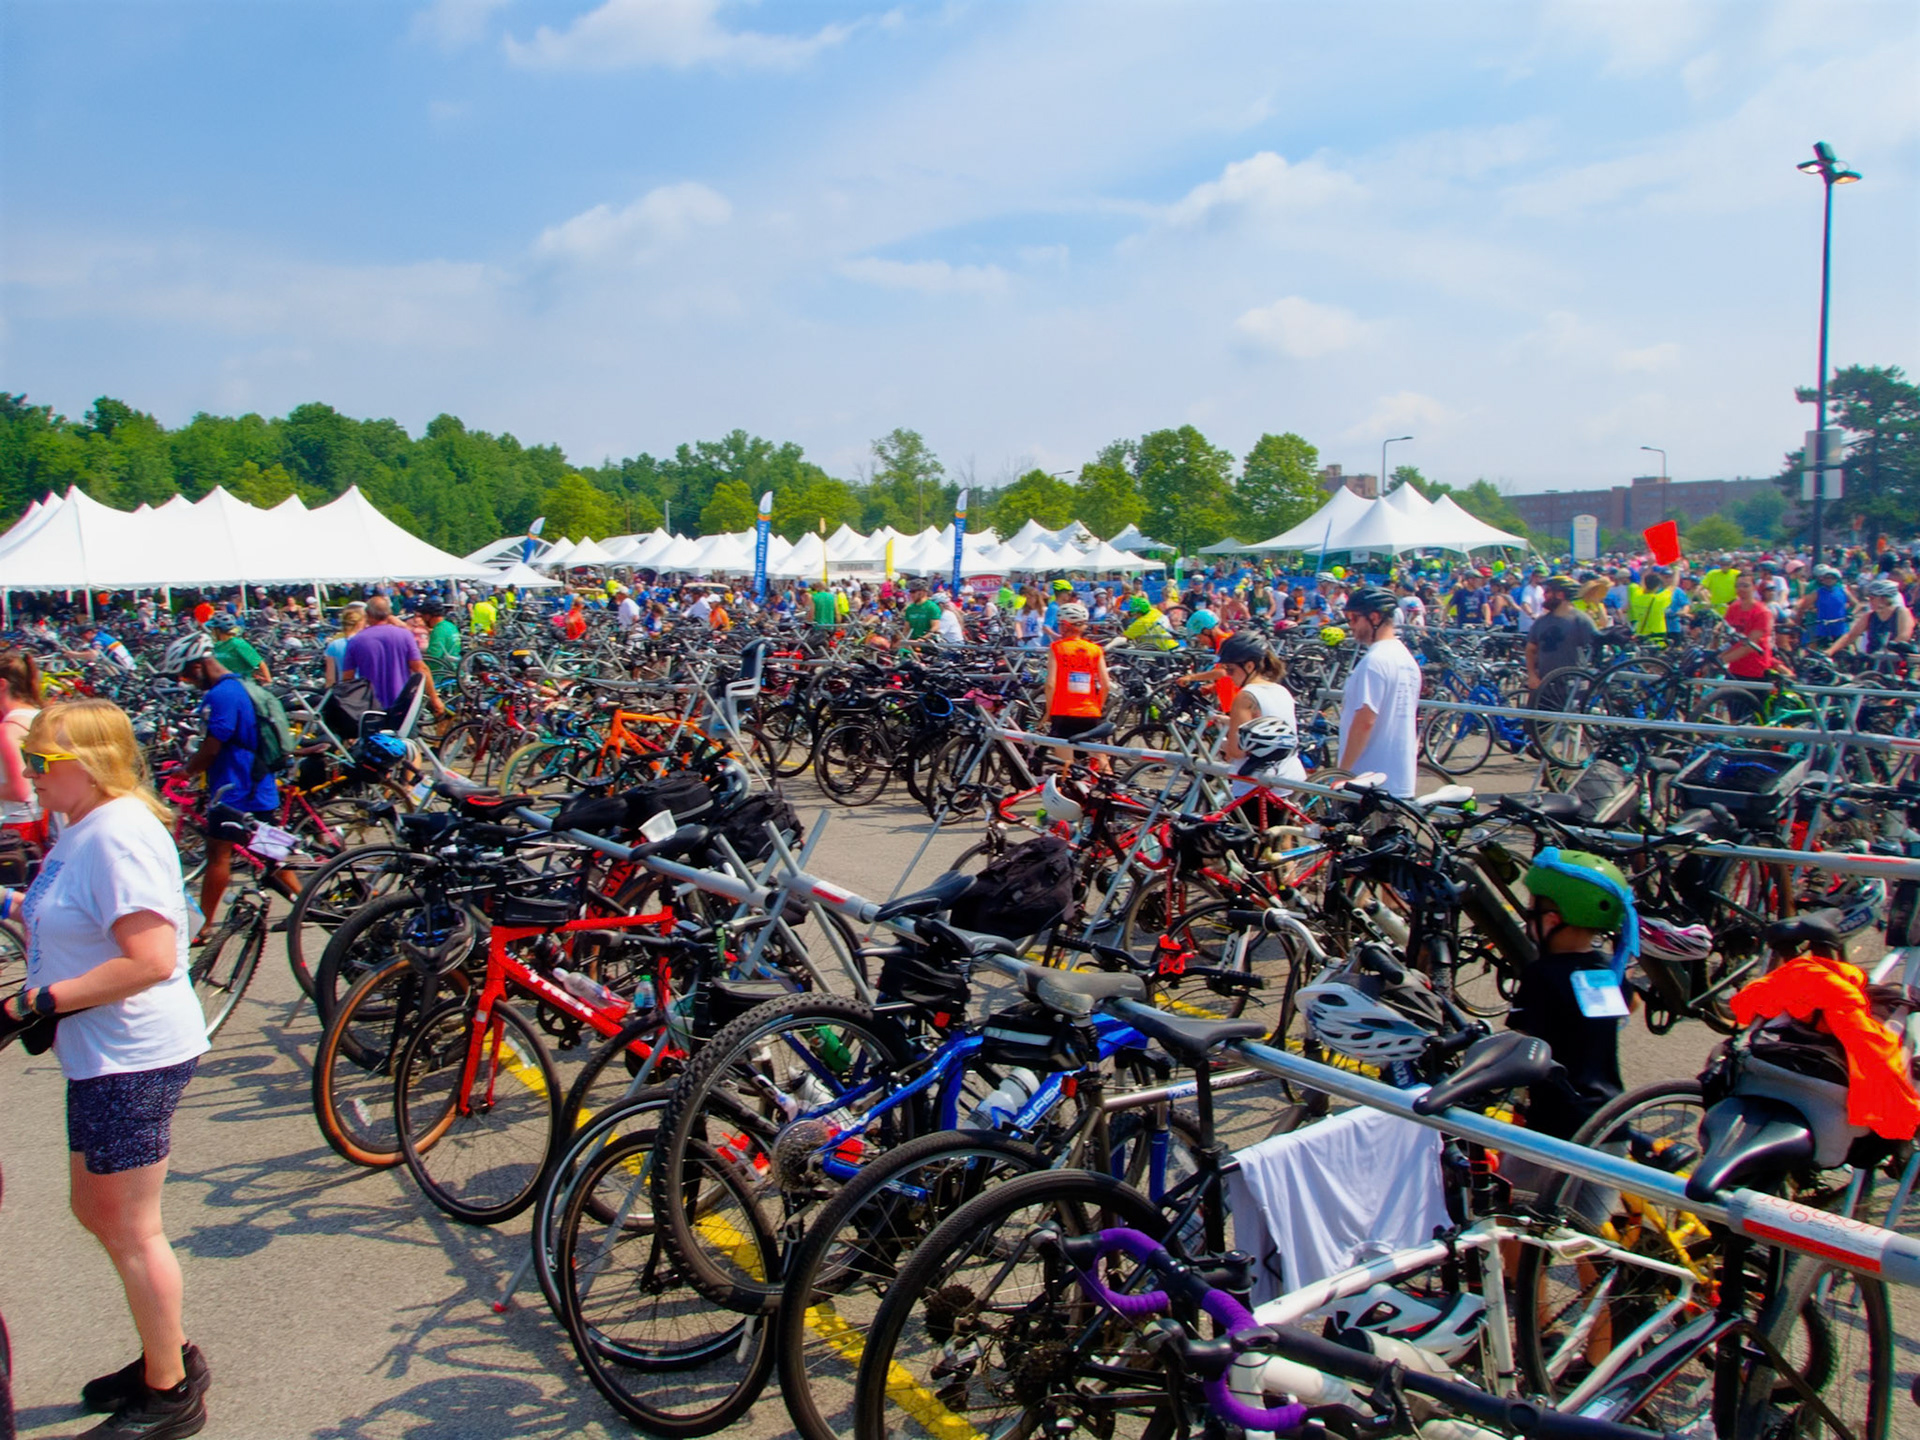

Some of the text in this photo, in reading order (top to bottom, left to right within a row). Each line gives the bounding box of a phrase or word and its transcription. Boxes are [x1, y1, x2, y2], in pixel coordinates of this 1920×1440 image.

[758, 544, 766, 560] TENT
[529, 972, 594, 1017] TREK
[1033, 1076, 1063, 1113] FISH
